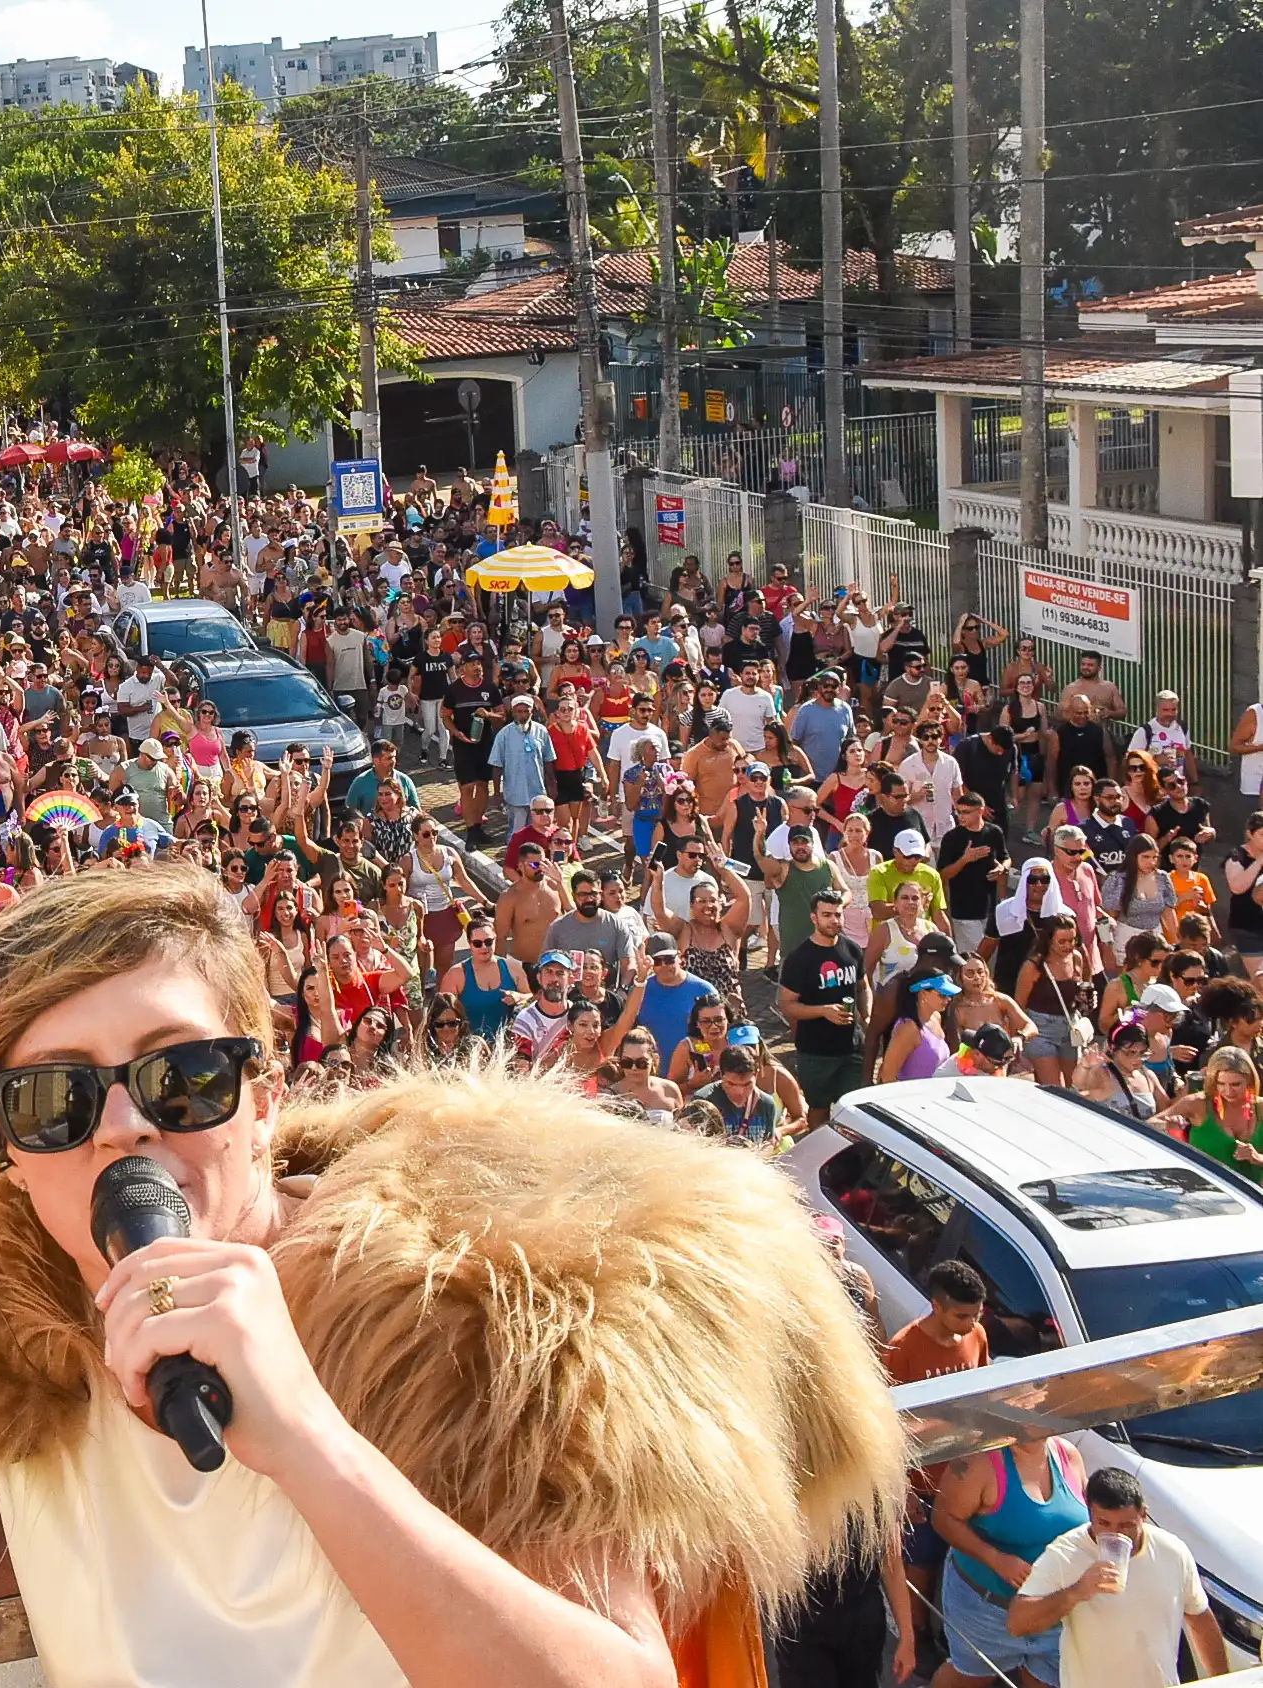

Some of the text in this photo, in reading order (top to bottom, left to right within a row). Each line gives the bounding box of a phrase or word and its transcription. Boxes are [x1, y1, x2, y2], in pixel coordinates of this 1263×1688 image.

[488, 580, 511, 590] SKOL
[1028, 575, 1126, 604] ALUGA-SE OU VENDE-SE
[1050, 593, 1099, 612] COMERCIAL
[1041, 607, 1110, 633] (11) 99384-6833
[818, 965, 856, 990] JAPAN
